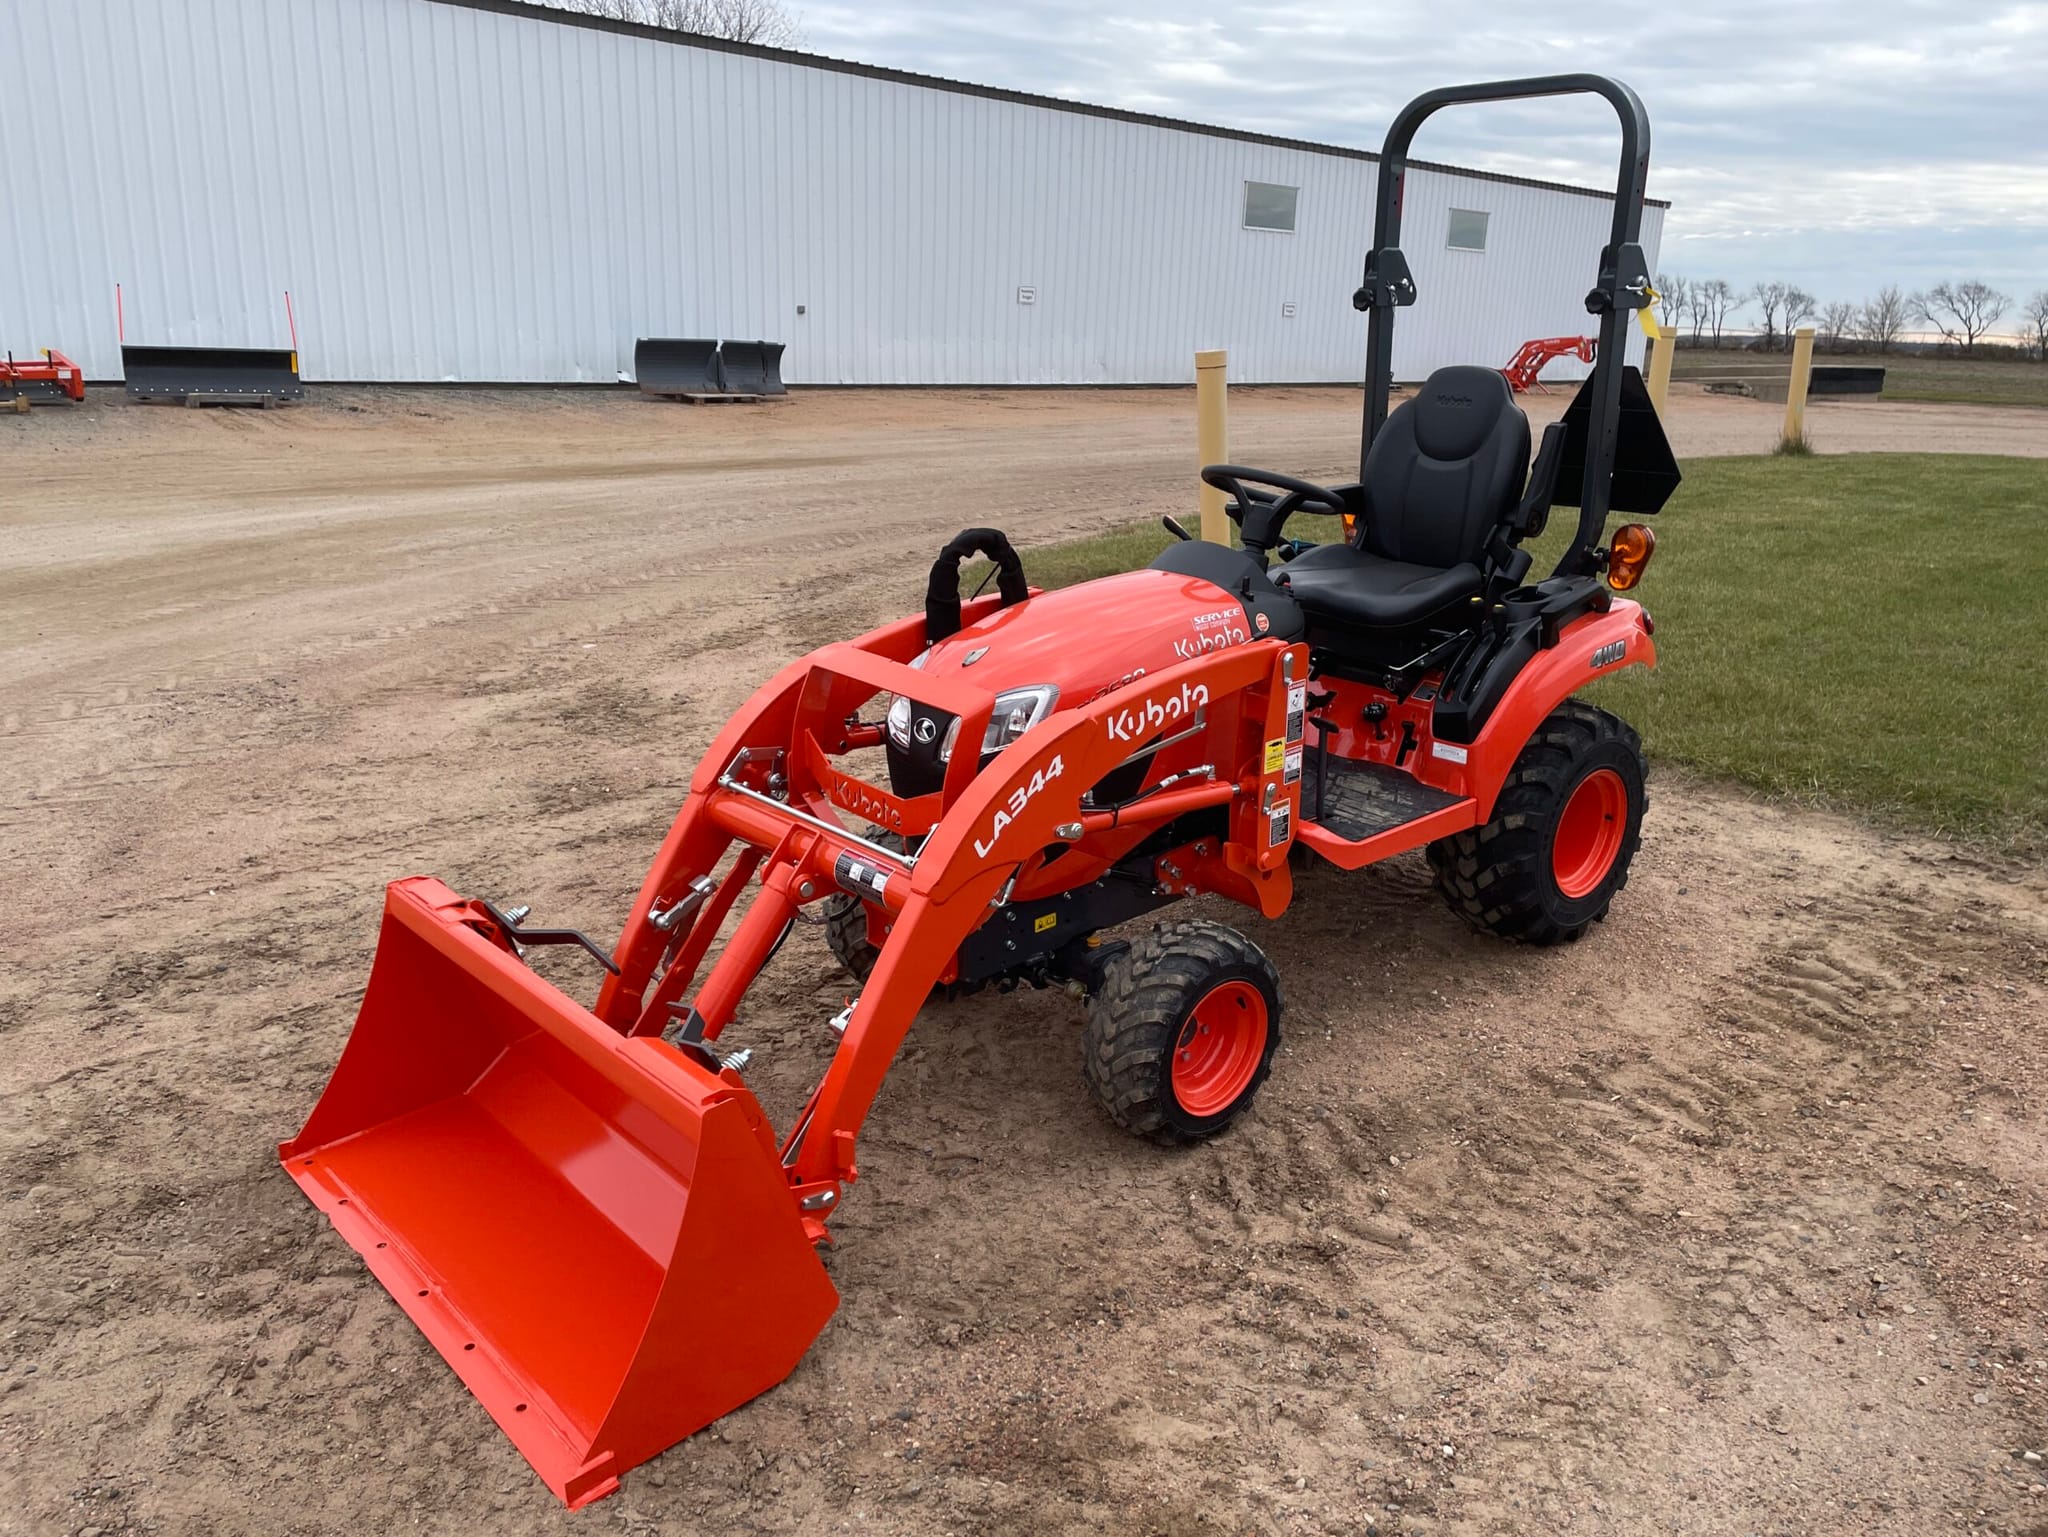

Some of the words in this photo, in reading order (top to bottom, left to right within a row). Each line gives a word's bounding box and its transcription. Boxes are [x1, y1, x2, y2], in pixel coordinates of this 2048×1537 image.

[1193, 607, 1240, 625] SERVICE
[1173, 626, 1245, 660] Kubota
[1590, 639, 1625, 668] 4WD
[1107, 683, 1209, 741] Kubota
[834, 776, 901, 827] Kubota
[974, 754, 1065, 858] LA344
